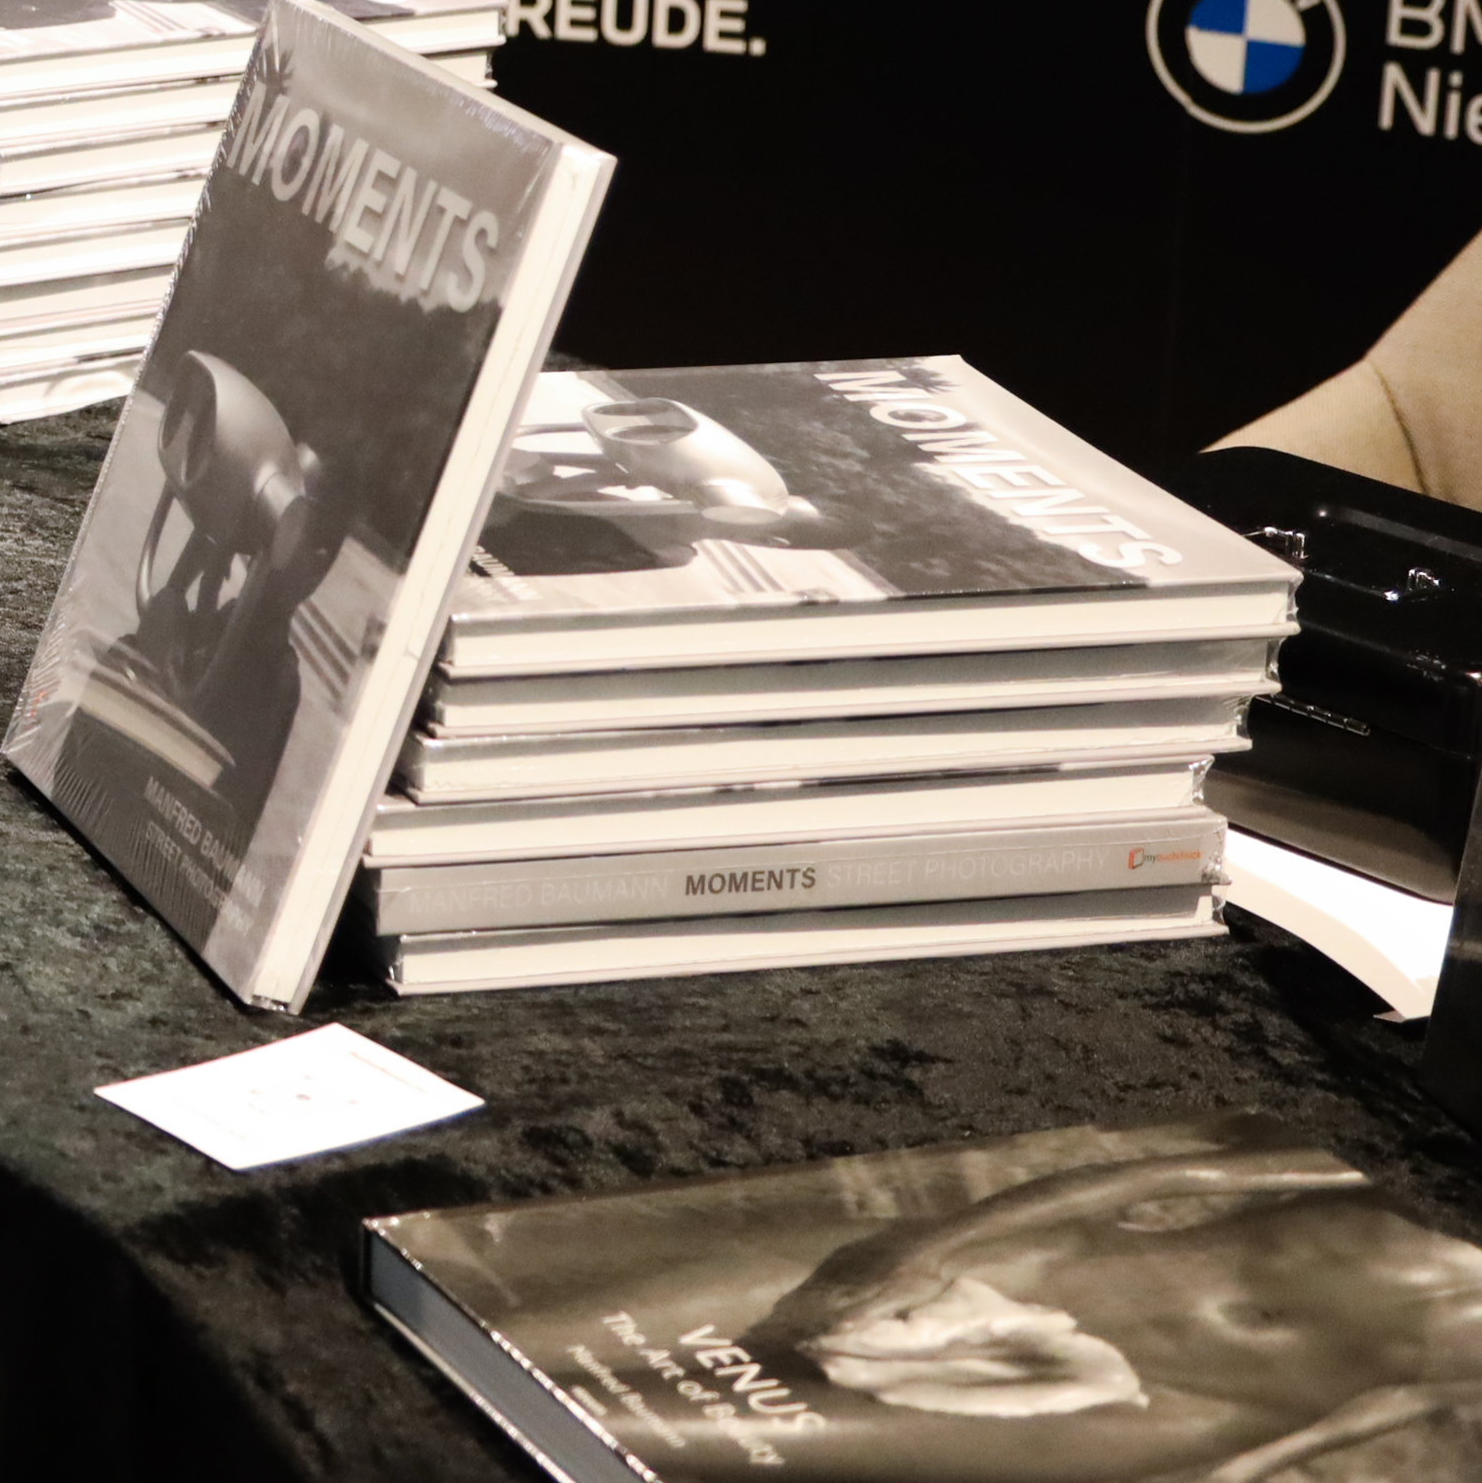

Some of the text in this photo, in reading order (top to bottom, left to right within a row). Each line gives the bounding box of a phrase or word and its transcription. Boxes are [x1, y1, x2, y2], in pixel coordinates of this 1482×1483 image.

[226, 80, 500, 314] MOMENTS
[813, 369, 1183, 569] MOMENTS
[408, 847, 1110, 915] MANFRED BAUMANN MOMENTS STREET PHOTOGRAPHY
[676, 1379, 722, 1402] of
[678, 1323, 827, 1432] VENUS
